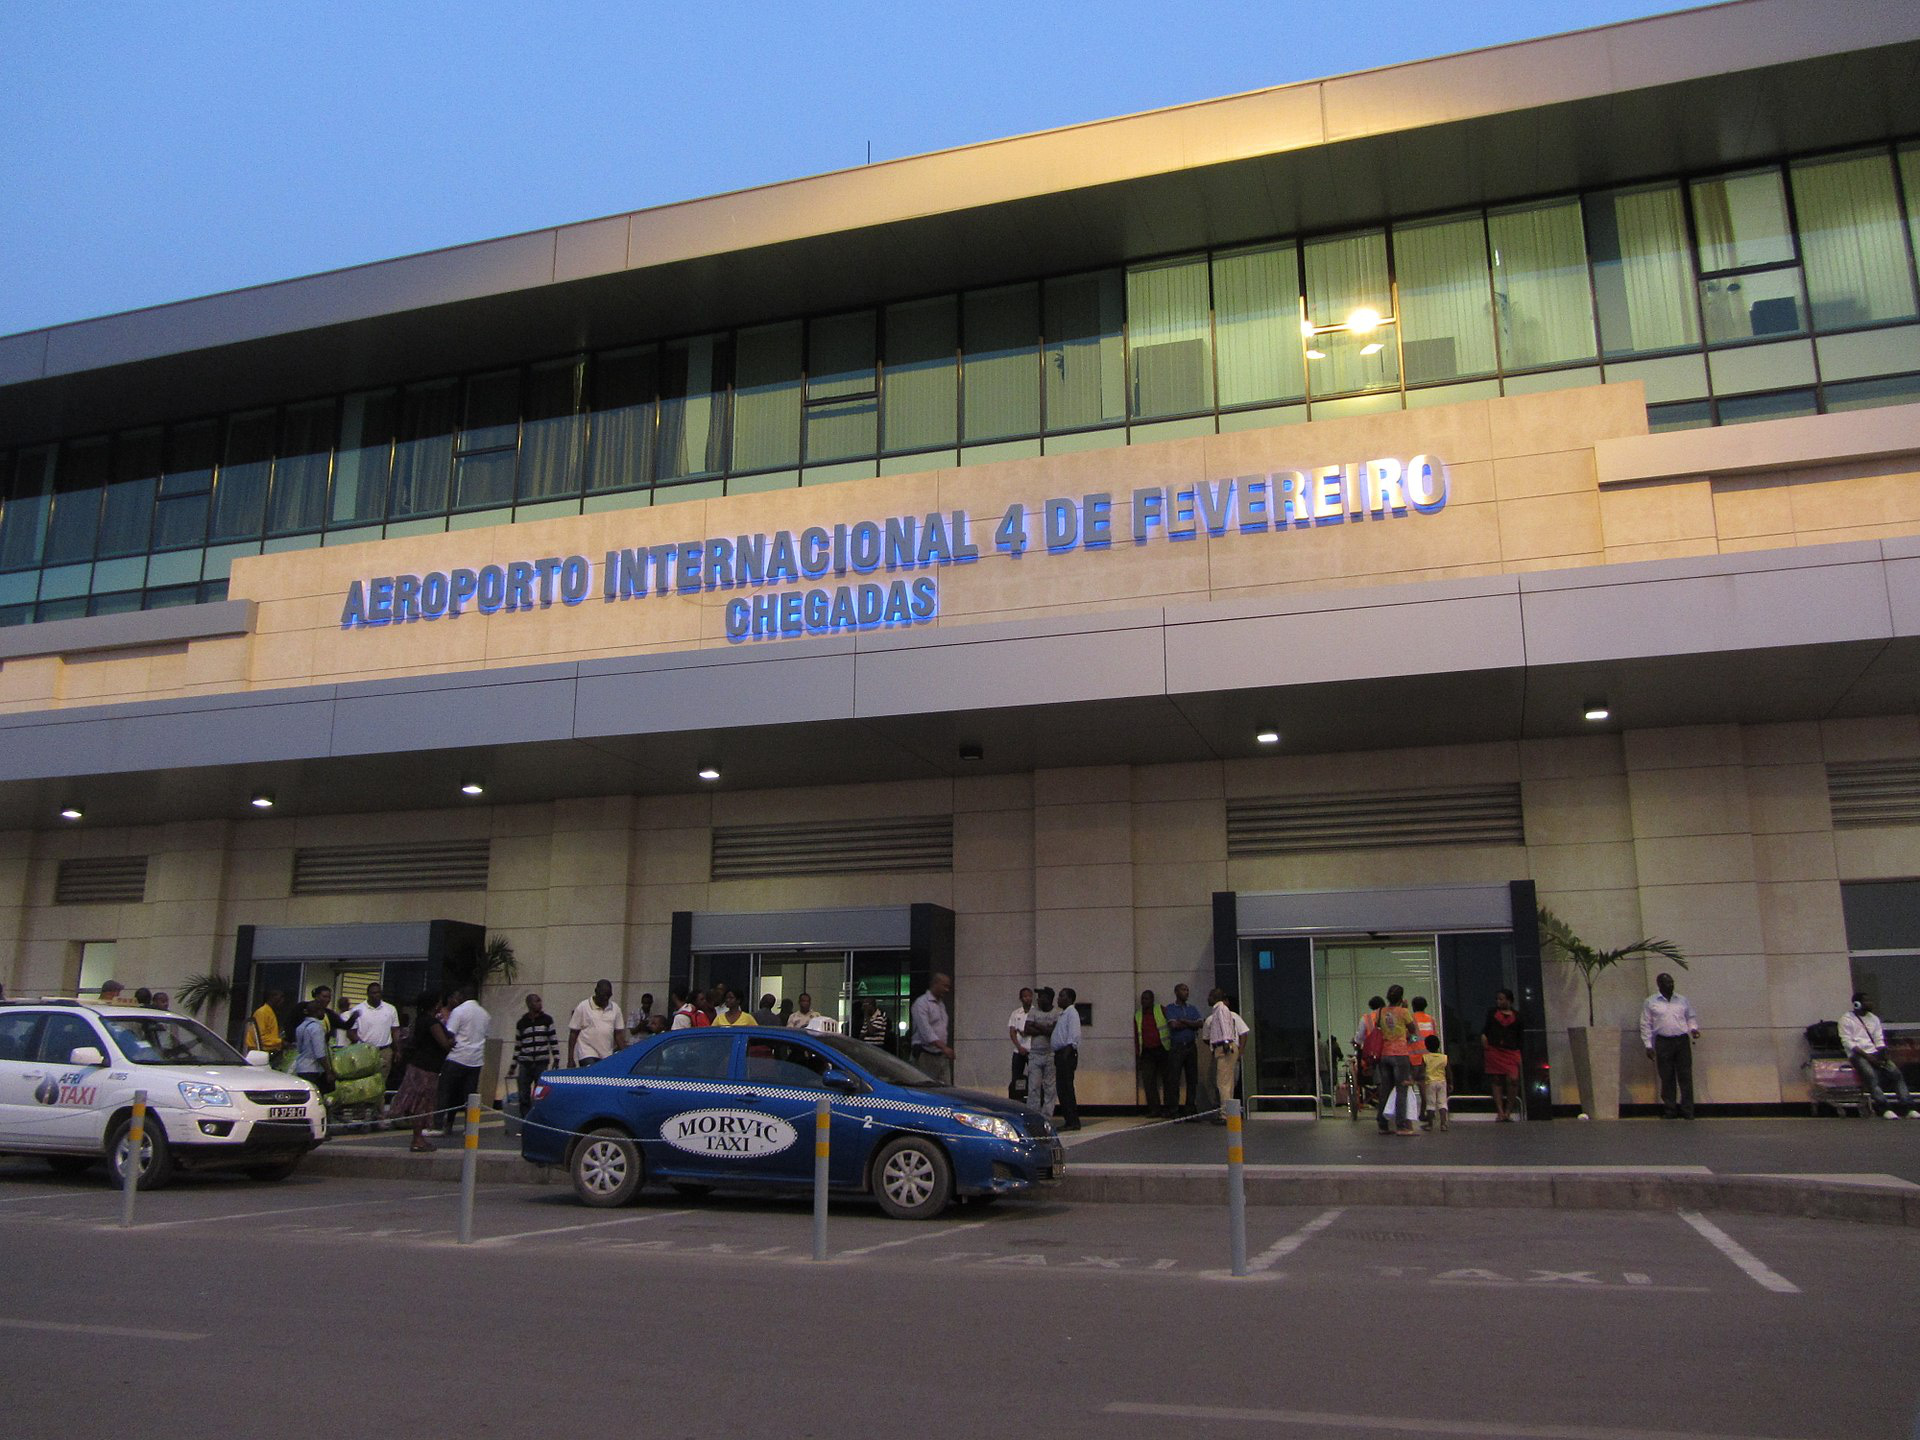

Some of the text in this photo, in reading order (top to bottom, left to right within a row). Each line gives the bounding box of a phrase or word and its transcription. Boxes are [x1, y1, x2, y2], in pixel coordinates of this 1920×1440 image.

[341, 454, 1447, 630] AEROPORTO INTERNACIONAL 4 DE FEVEREIRO
[725, 576, 937, 644] CHEGADAS
[58, 1072, 83, 1085] AFRI
[59, 1086, 97, 1105] TAXI
[678, 1115, 778, 1144] MORVIC
[863, 1115, 873, 1129] 2
[703, 1135, 749, 1152] TAXI
[1365, 1265, 1654, 1284] TAXI
